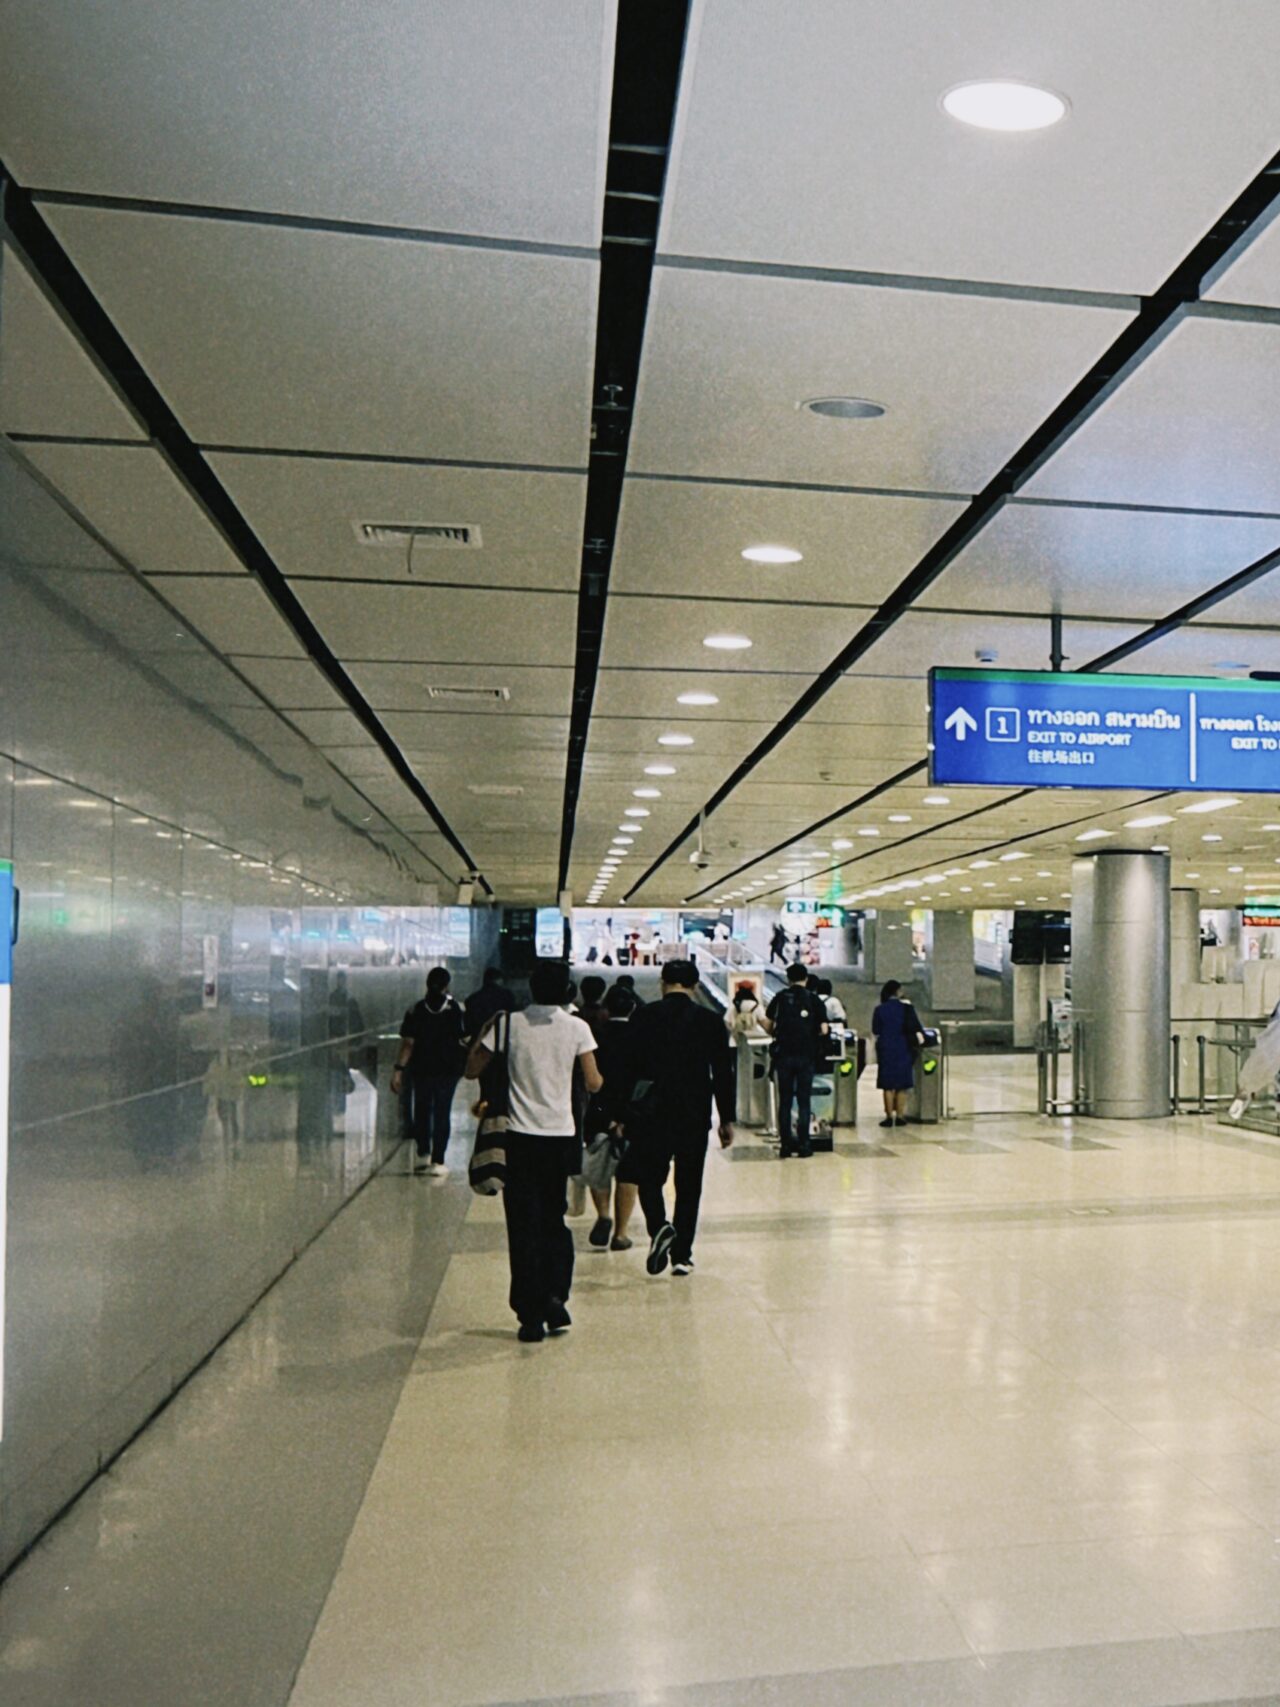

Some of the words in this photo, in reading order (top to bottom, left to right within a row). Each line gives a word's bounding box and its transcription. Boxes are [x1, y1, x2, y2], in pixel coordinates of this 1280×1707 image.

[997, 716, 1009, 735] 1
[1027, 709, 1100, 726] ทางออก
[1105, 708, 1181, 729] สนามบิน
[1199, 717, 1254, 731] ทางออก
[1027, 731, 1056, 743] EXIT
[1059, 731, 1076, 744] TO
[1078, 732, 1132, 745] AIRPORT
[1231, 737, 1259, 749] EXIT
[1261, 737, 1277, 750] TO
